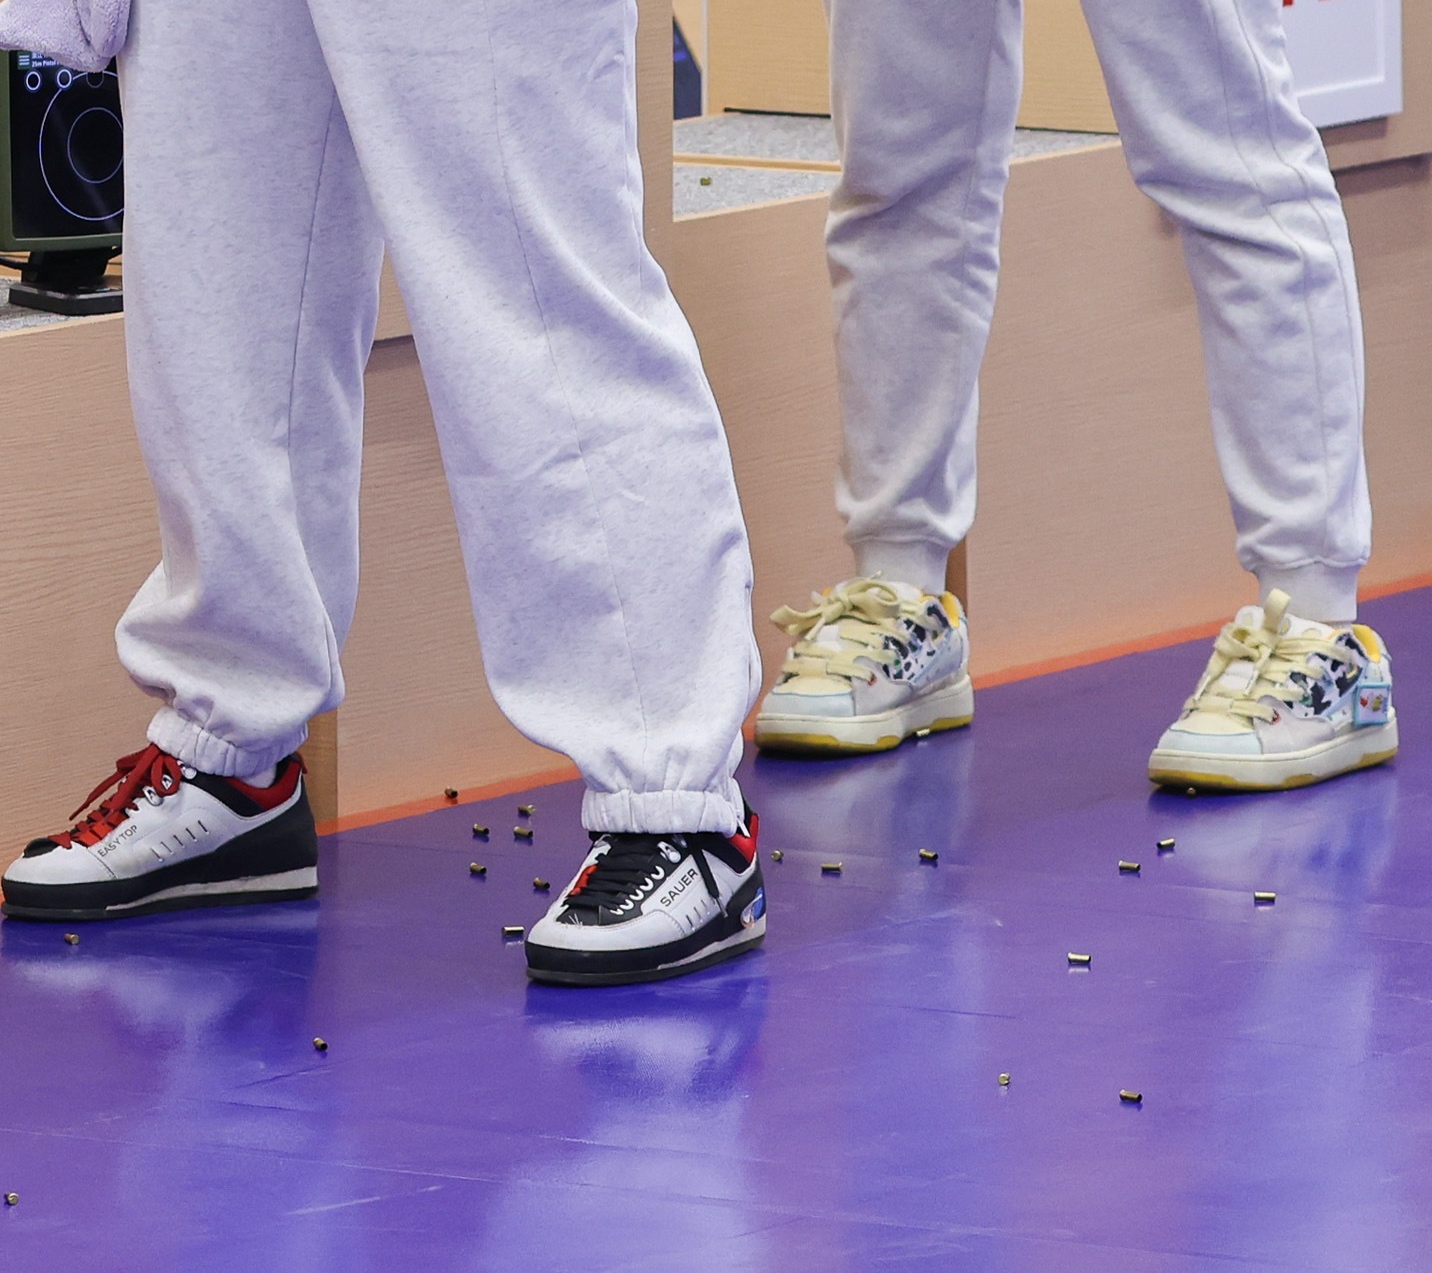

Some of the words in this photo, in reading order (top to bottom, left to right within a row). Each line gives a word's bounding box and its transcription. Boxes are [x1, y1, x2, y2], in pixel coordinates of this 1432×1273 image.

[97, 837, 121, 858] EASY
[118, 824, 138, 840] TOP
[660, 867, 698, 908] SAUER
